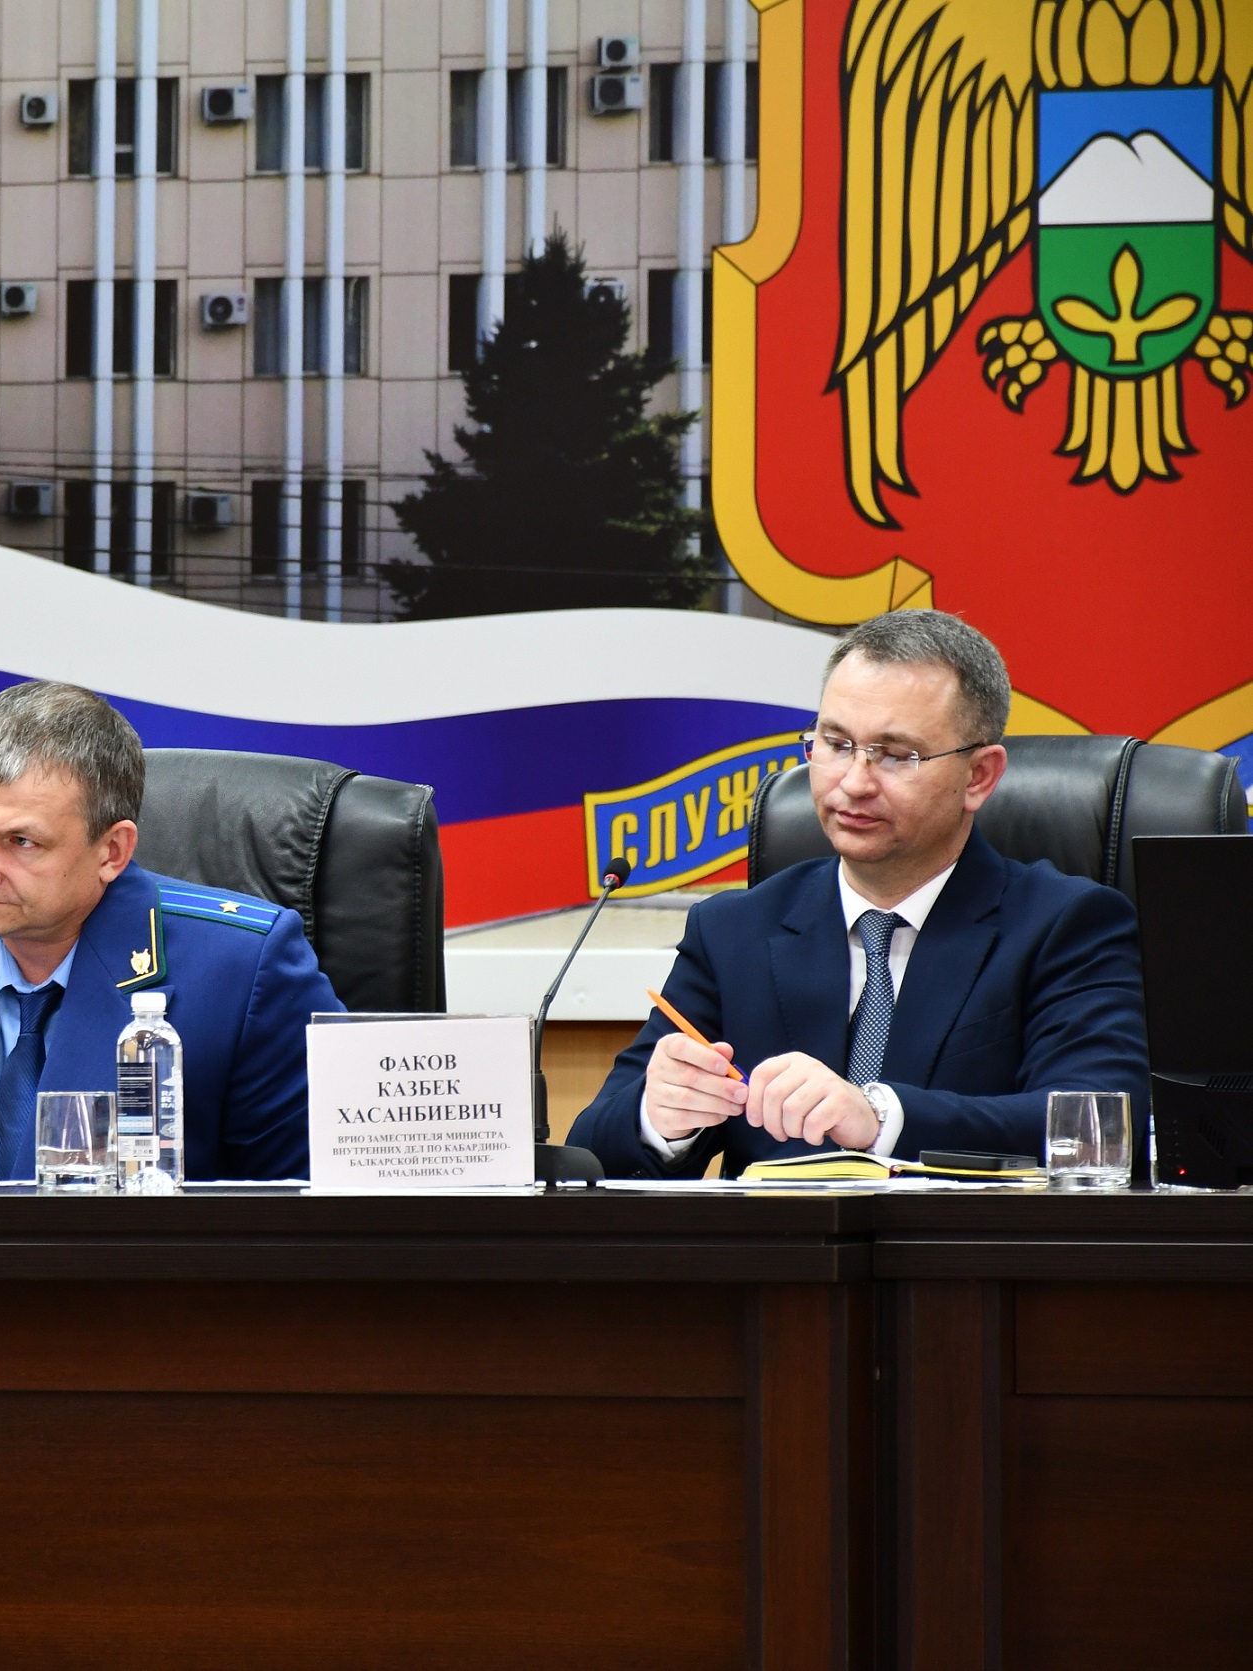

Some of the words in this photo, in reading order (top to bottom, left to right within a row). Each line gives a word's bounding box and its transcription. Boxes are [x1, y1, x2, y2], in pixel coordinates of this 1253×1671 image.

[611, 756, 799, 872] СЛУЖ
[379, 1053, 457, 1072] ФАКОВ
[378, 1079, 461, 1098] КАЗБЕК
[337, 1103, 502, 1124] ХАСАНБИЕВИЧ
[337, 1134, 366, 1144] ВРИО
[367, 1132, 443, 1143] ЗАМЕСТИТЕЛЯ
[445, 1130, 504, 1141] МИНИСТРА
[332, 1145, 402, 1156] ВНУТРЕННИХ
[403, 1144, 425, 1155] ДЕЛ
[426, 1144, 443, 1153] ПО
[444, 1142, 511, 1153] КАБАРДИНО-
[349, 1155, 419, 1167] БАЛКАРСКОЙ
[421, 1154, 494, 1165] РЕСПУБЛИКЕ-
[378, 1167, 450, 1178] НАЧАЛЬНИКА
[451, 1167, 466, 1176] СУ
